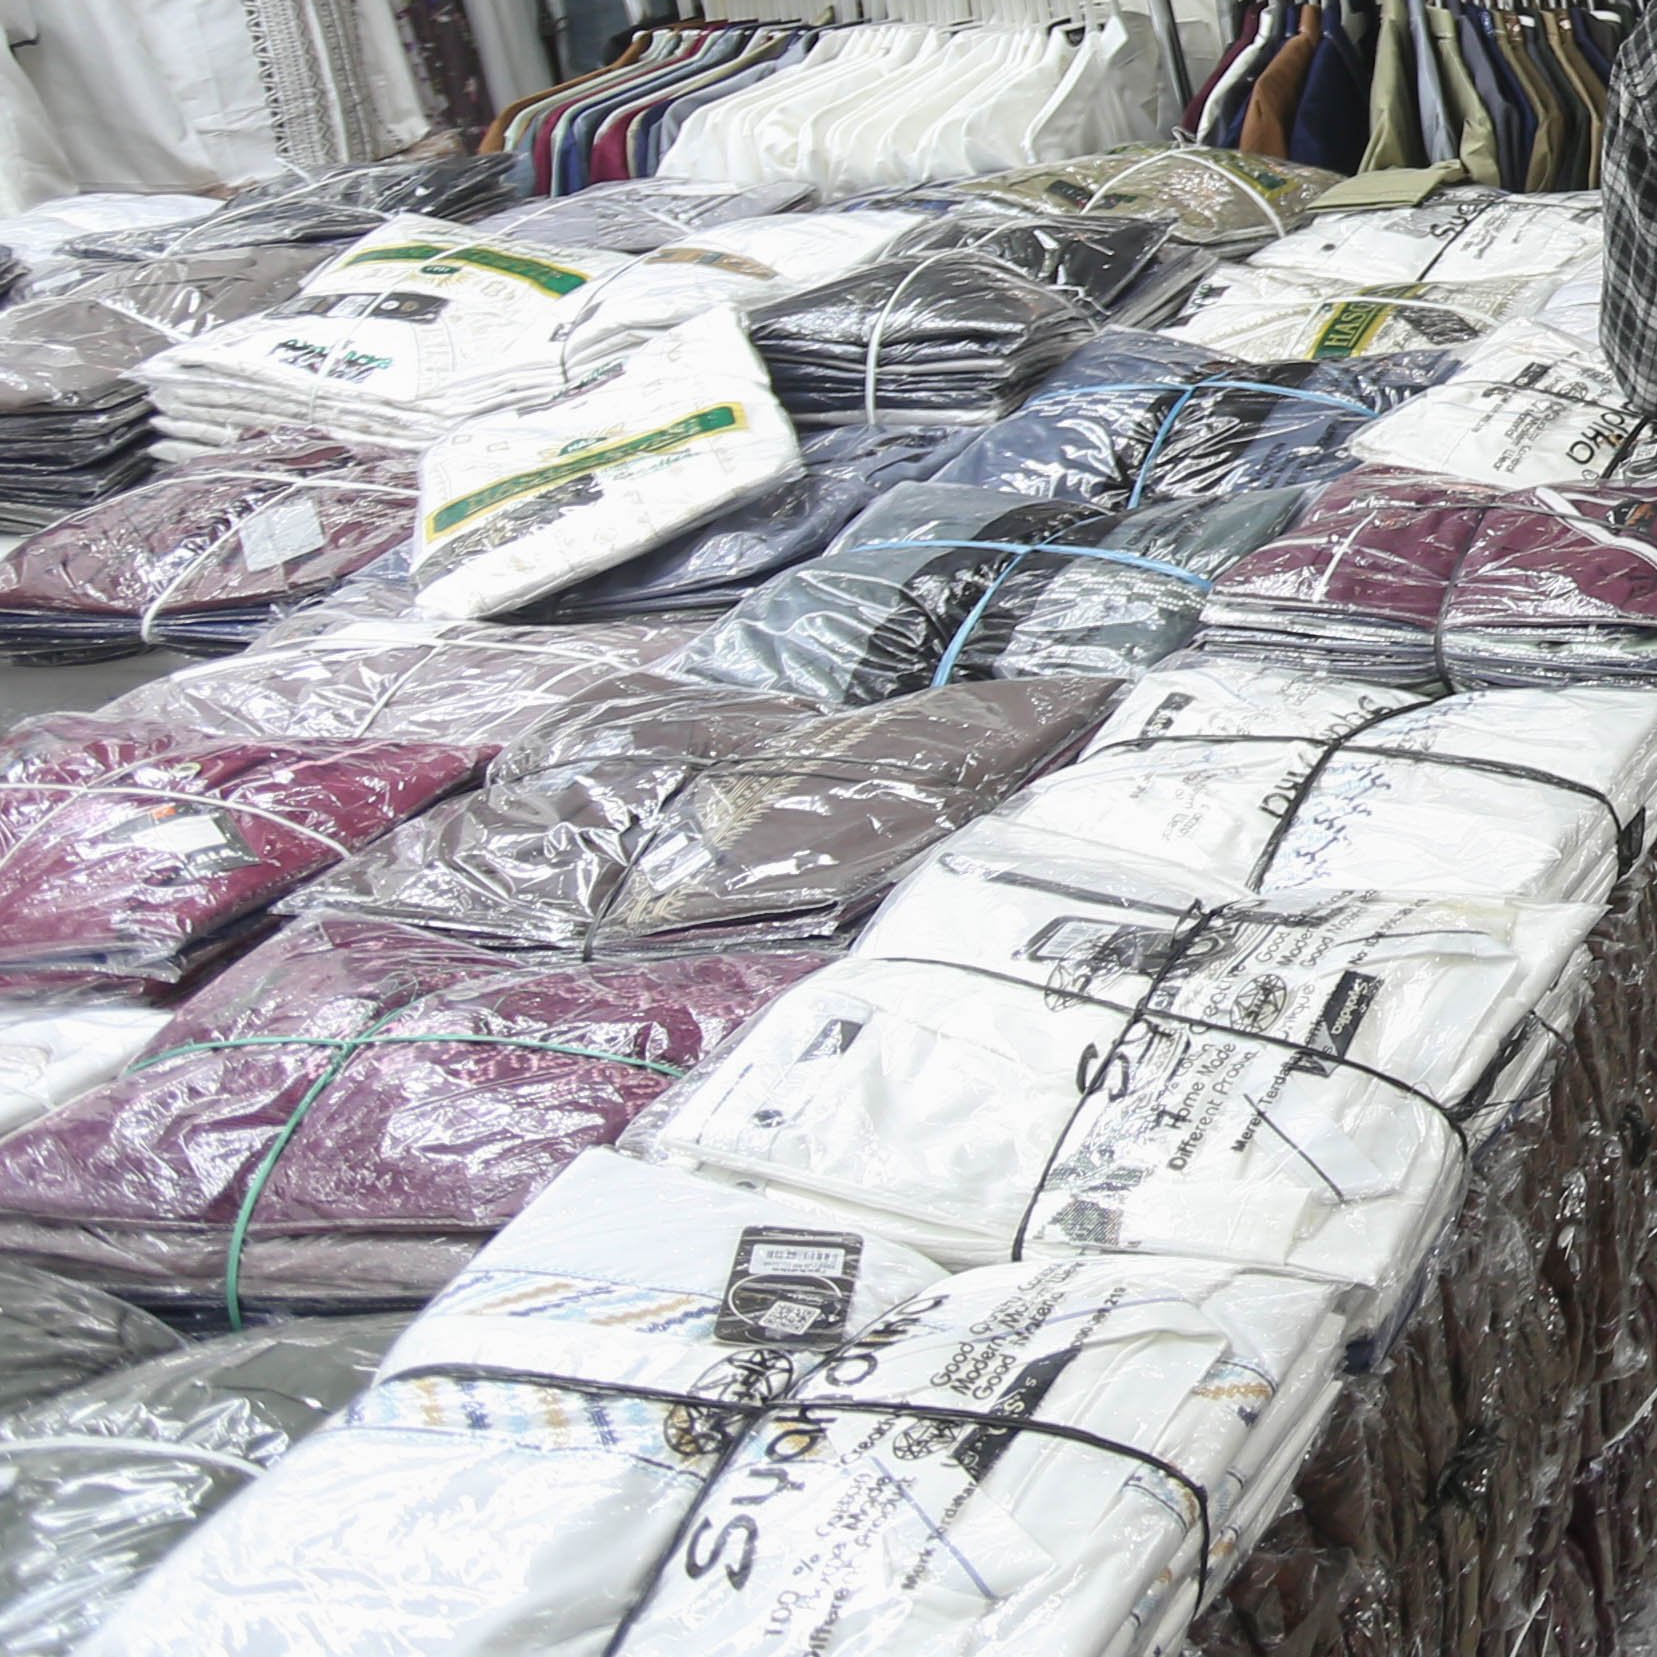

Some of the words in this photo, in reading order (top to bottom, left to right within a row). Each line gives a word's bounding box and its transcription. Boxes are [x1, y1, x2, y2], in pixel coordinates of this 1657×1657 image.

[1197, 1042, 1236, 1077] Made
[1168, 1100, 1223, 1171] Different
[930, 1341, 975, 1387] Good
[951, 1336, 1007, 1396] Modern
[971, 1353, 1016, 1401] Good
[763, 1589, 801, 1636] 100
[791, 1553, 821, 1576] %
